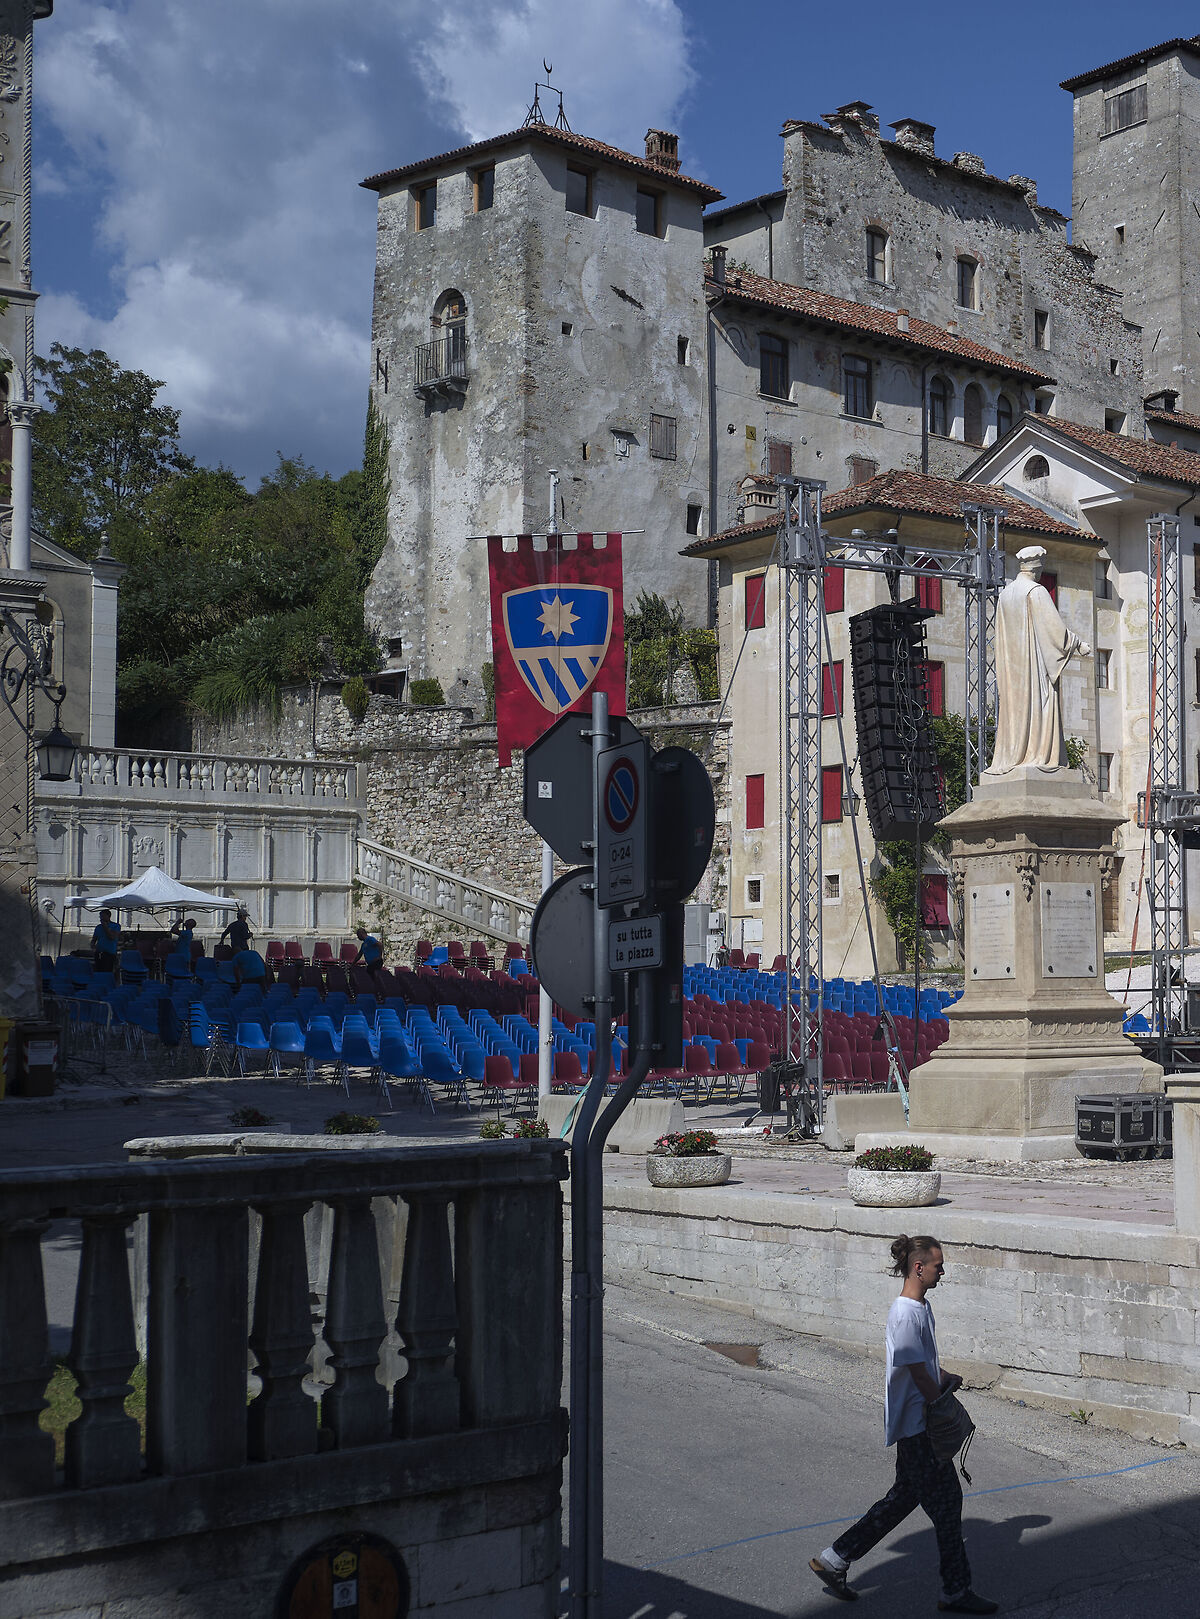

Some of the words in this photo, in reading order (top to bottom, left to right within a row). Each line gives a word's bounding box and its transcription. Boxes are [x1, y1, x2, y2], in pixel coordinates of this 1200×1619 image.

[612, 845, 630, 862] 0-24
[617, 931, 627, 943] su
[631, 926, 653, 941] tutta
[616, 949, 624, 962] la
[628, 947, 654, 963] piazza
